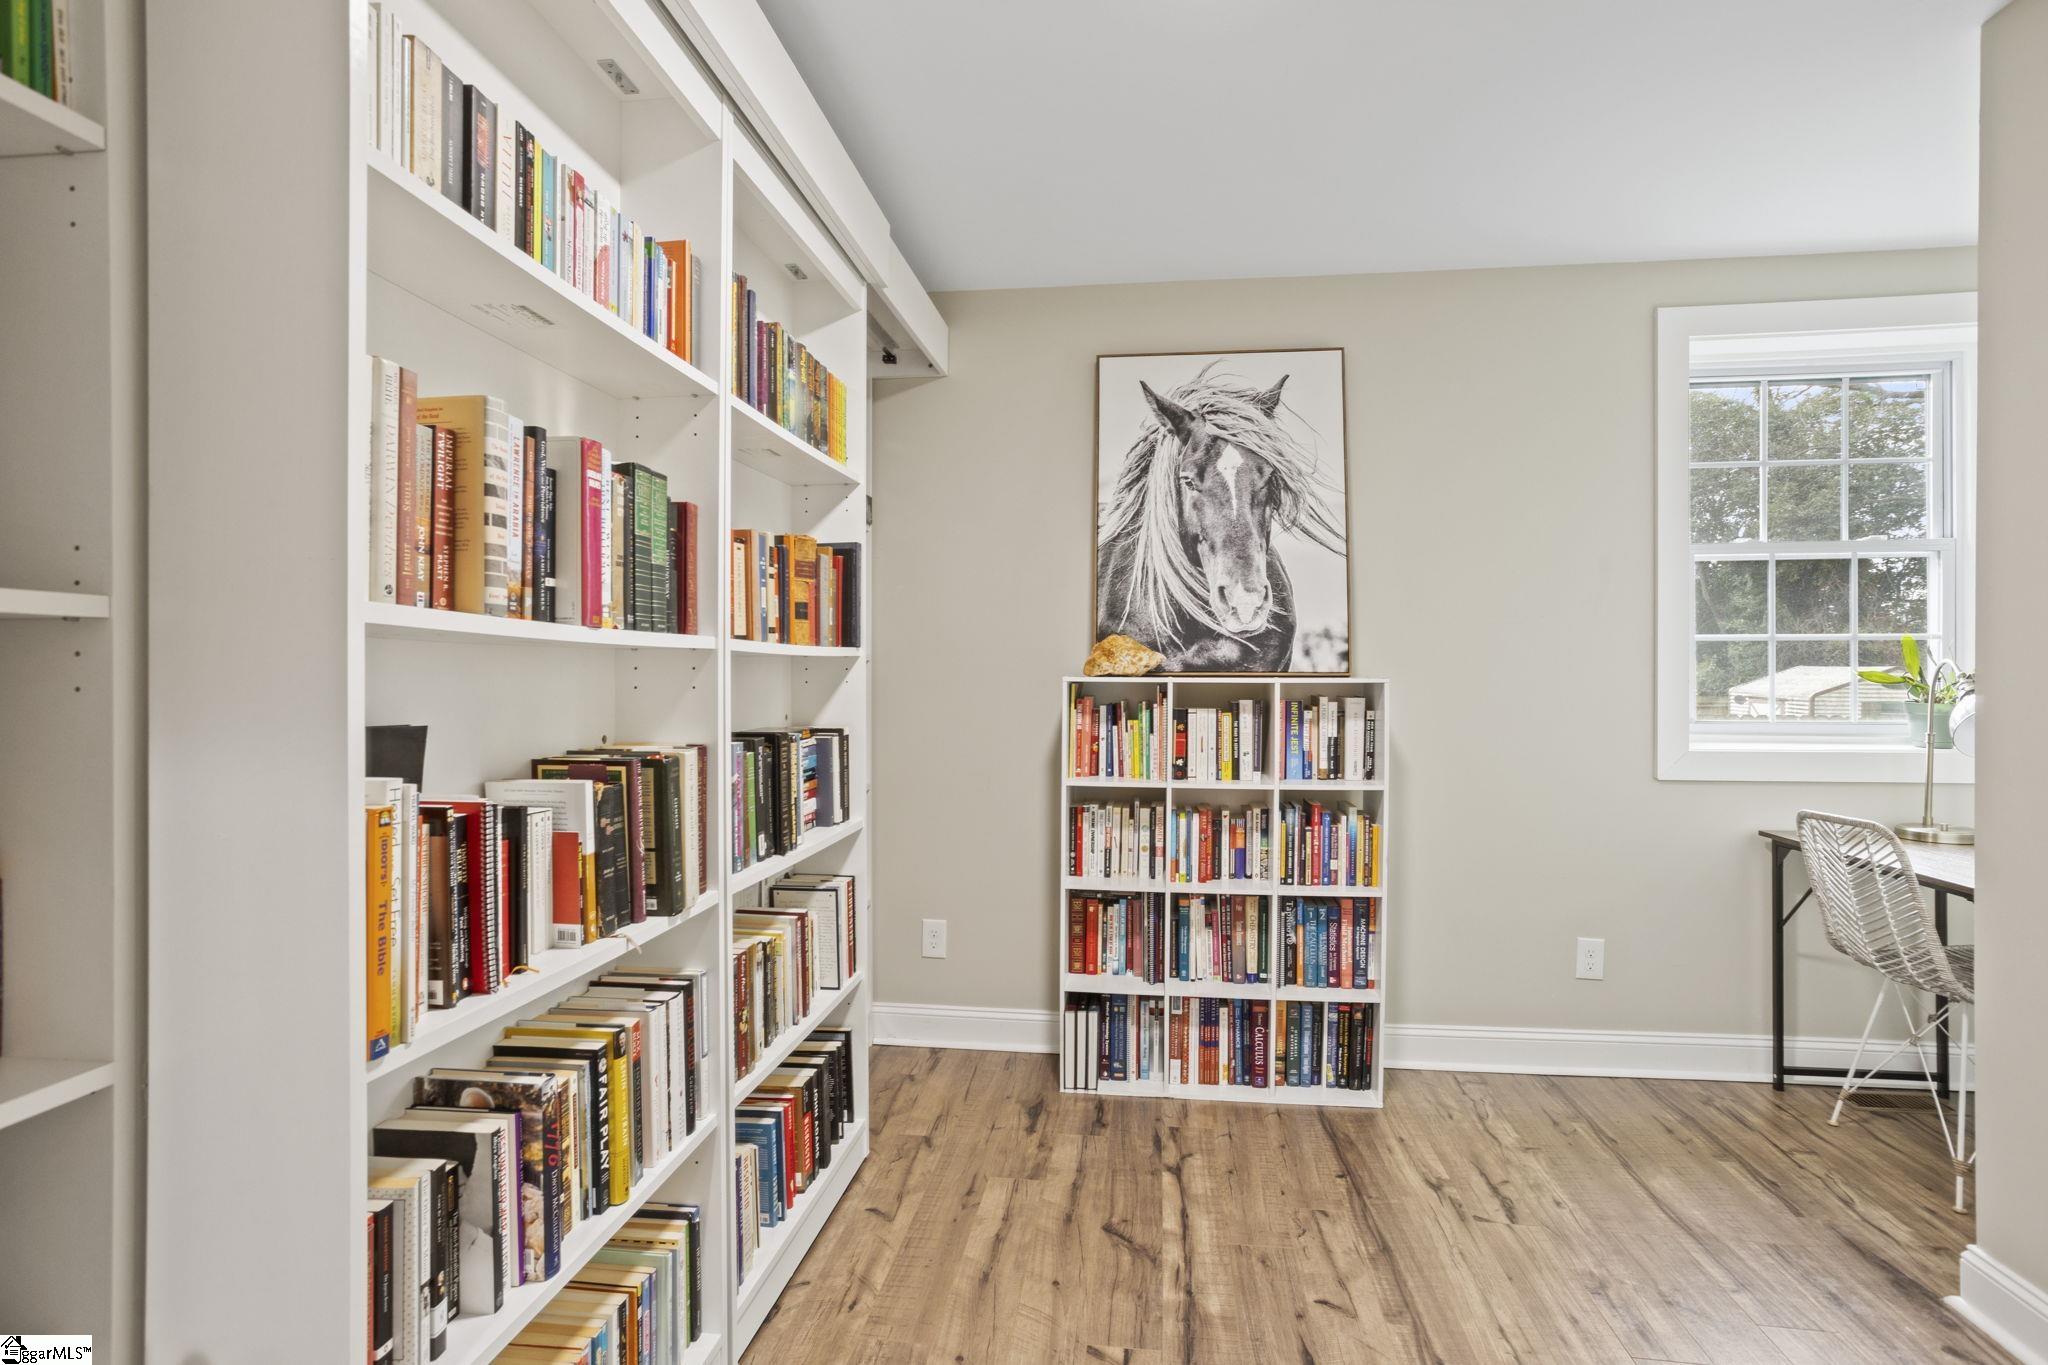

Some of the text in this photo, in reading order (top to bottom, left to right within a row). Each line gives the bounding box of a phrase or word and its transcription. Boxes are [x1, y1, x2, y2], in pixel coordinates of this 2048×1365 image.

[437, 430, 446, 490] TWILIGHT
[445, 433, 453, 490] IMPERIAL
[417, 525, 425, 580] JOHN KEAY
[1290, 701, 1299, 755] INFINITE JEST
[376, 900, 388, 977] The Bible
[1329, 922, 1338, 951] Statistics
[687, 996, 695, 1070] BAD BLOOD
[1255, 1026, 1265, 1065] CALCULUS
[544, 1121, 560, 1166] 1776
[598, 1073, 610, 1172] FAIR PLAY
[743, 1155, 751, 1209] RASPUTIN
